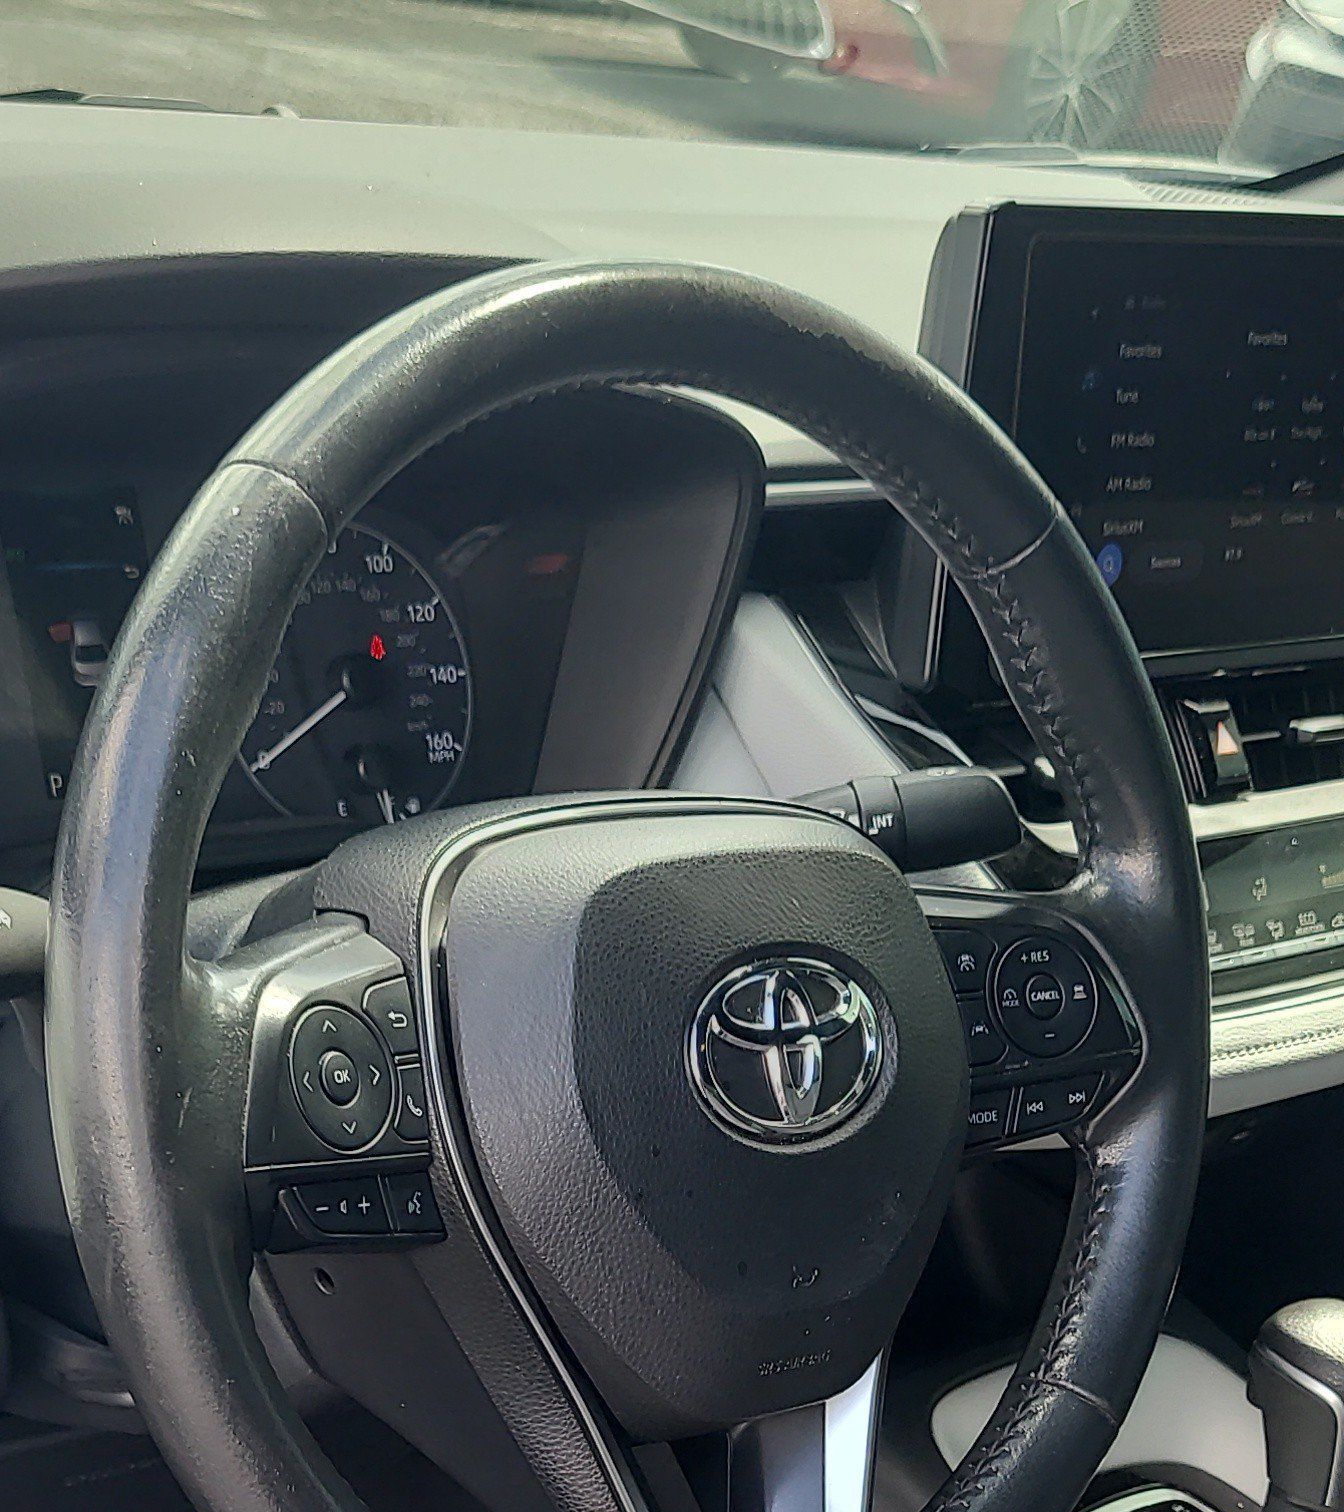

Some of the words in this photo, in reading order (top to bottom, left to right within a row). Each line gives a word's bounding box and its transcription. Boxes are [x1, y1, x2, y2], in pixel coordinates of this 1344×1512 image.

[365, 554, 394, 574] 100
[407, 604, 436, 623] 120
[429, 666, 458, 685] 140
[425, 732, 454, 751] 160
[428, 750, 455, 764] MPH
[49, 773, 63, 798] P
[336, 800, 350, 818] E
[1030, 989, 1060, 1002] CANCEL
[333, 1068, 351, 1084] OK
[968, 1109, 999, 1125] MODE
